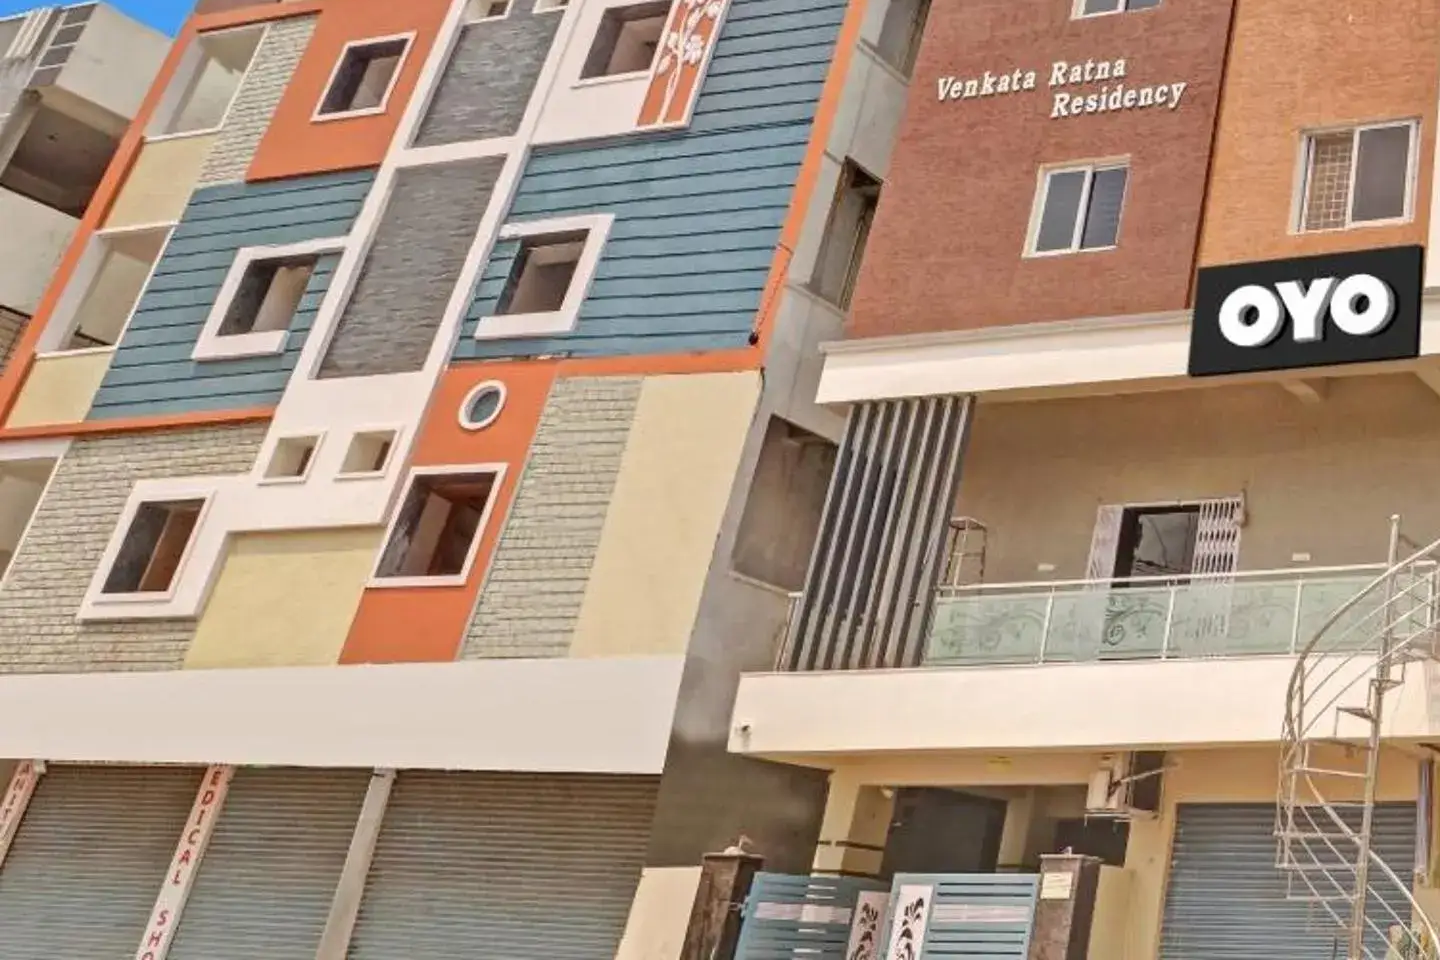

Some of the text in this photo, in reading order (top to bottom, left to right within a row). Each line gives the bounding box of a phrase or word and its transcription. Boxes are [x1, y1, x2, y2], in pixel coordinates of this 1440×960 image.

[937, 58, 1127, 101] Venkata Ratna
[1050, 81, 1188, 118] Residency
[1219, 273, 1396, 348] OYO
[172, 763, 229, 885] EDICAL
